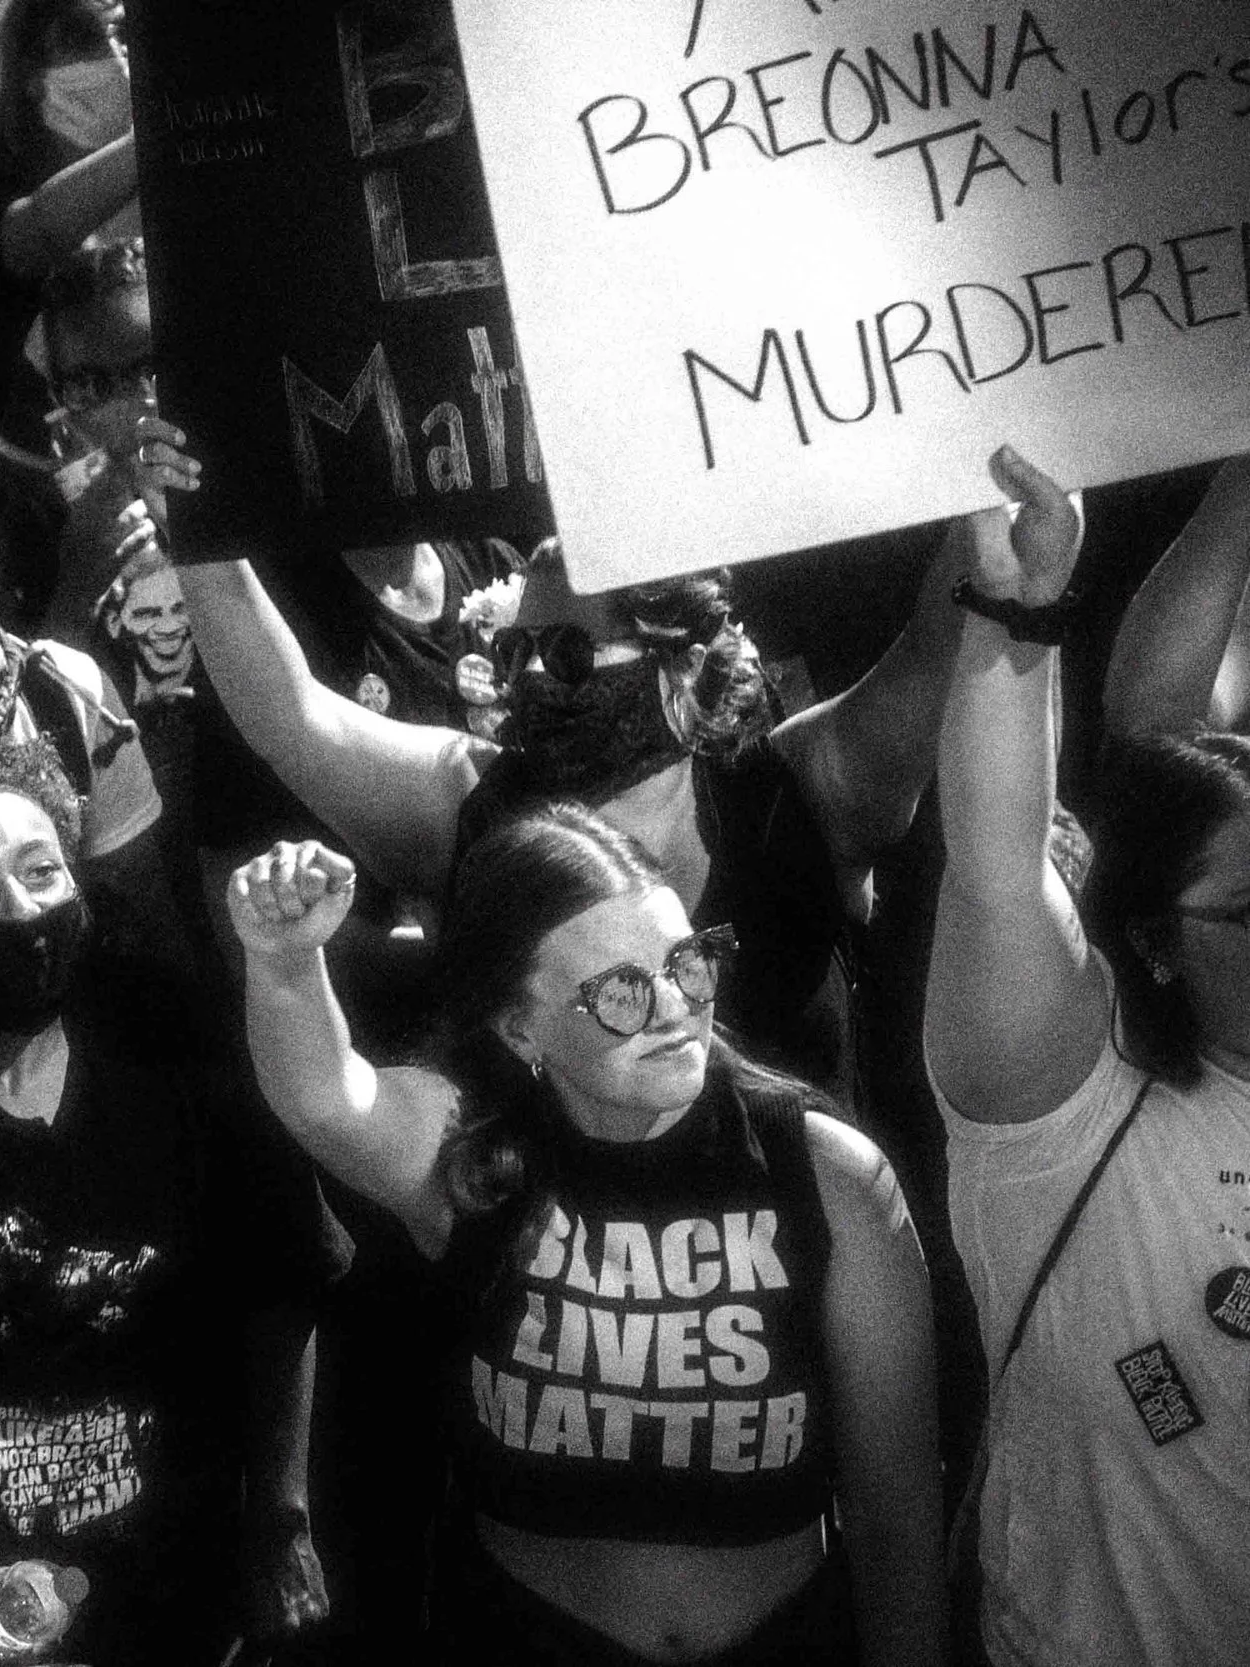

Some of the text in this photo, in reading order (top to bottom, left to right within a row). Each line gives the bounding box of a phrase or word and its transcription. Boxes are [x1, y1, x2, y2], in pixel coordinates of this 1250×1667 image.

[577, 8, 1066, 215] BREONNA
[682, 222, 1250, 470] MURDERE
[1219, 1169, 1250, 1185] un
[512, 1290, 771, 1389] LIVES
[471, 1354, 808, 1473] MATTER
[7, 1464, 43, 1490] CAN
